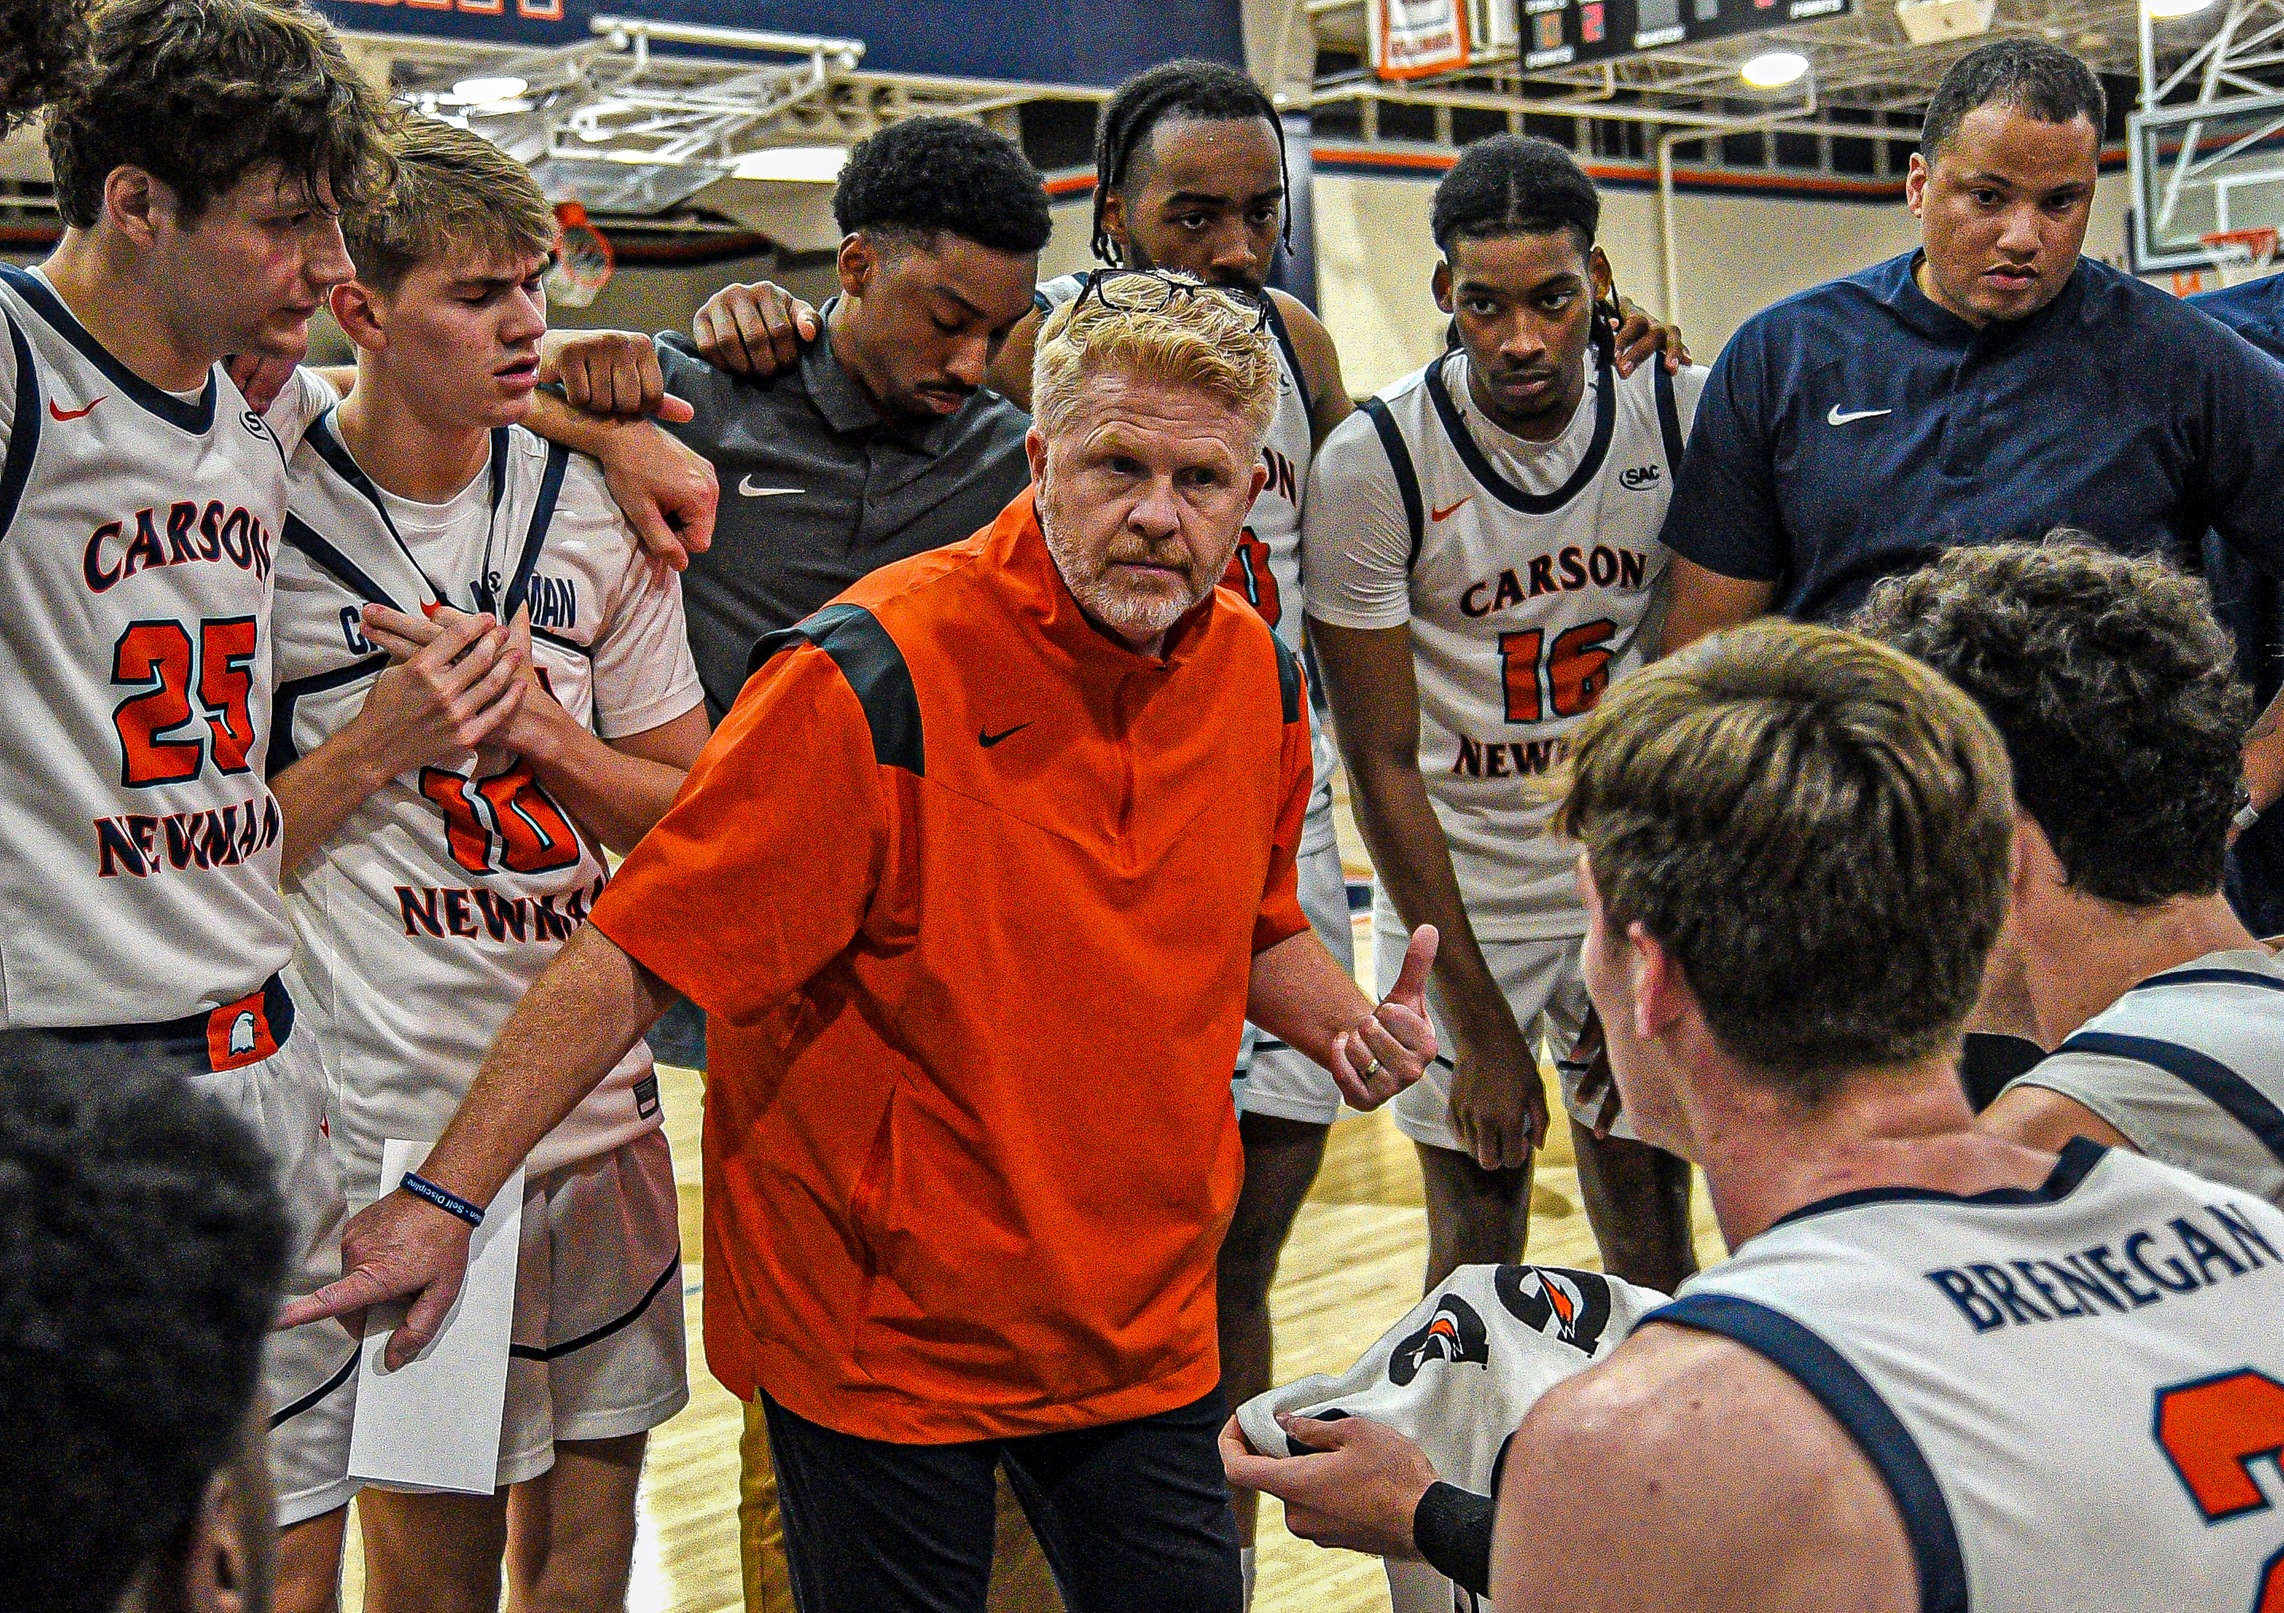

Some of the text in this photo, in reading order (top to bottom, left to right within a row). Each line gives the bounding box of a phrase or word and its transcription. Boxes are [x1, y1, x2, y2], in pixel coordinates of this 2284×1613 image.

[1625, 465, 1660, 486] SAC
[83, 499, 272, 594] CARSON
[1460, 545, 1647, 618] CARSON
[110, 615, 257, 789] 25
[1498, 617, 1618, 725] 16
[1453, 733, 1556, 778] NEW
[418, 755, 581, 876] 10
[407, 1179, 446, 1205] Discipline
[445, 1199, 465, 1214] Self
[1923, 1203, 2284, 1335] BRENEGAN
